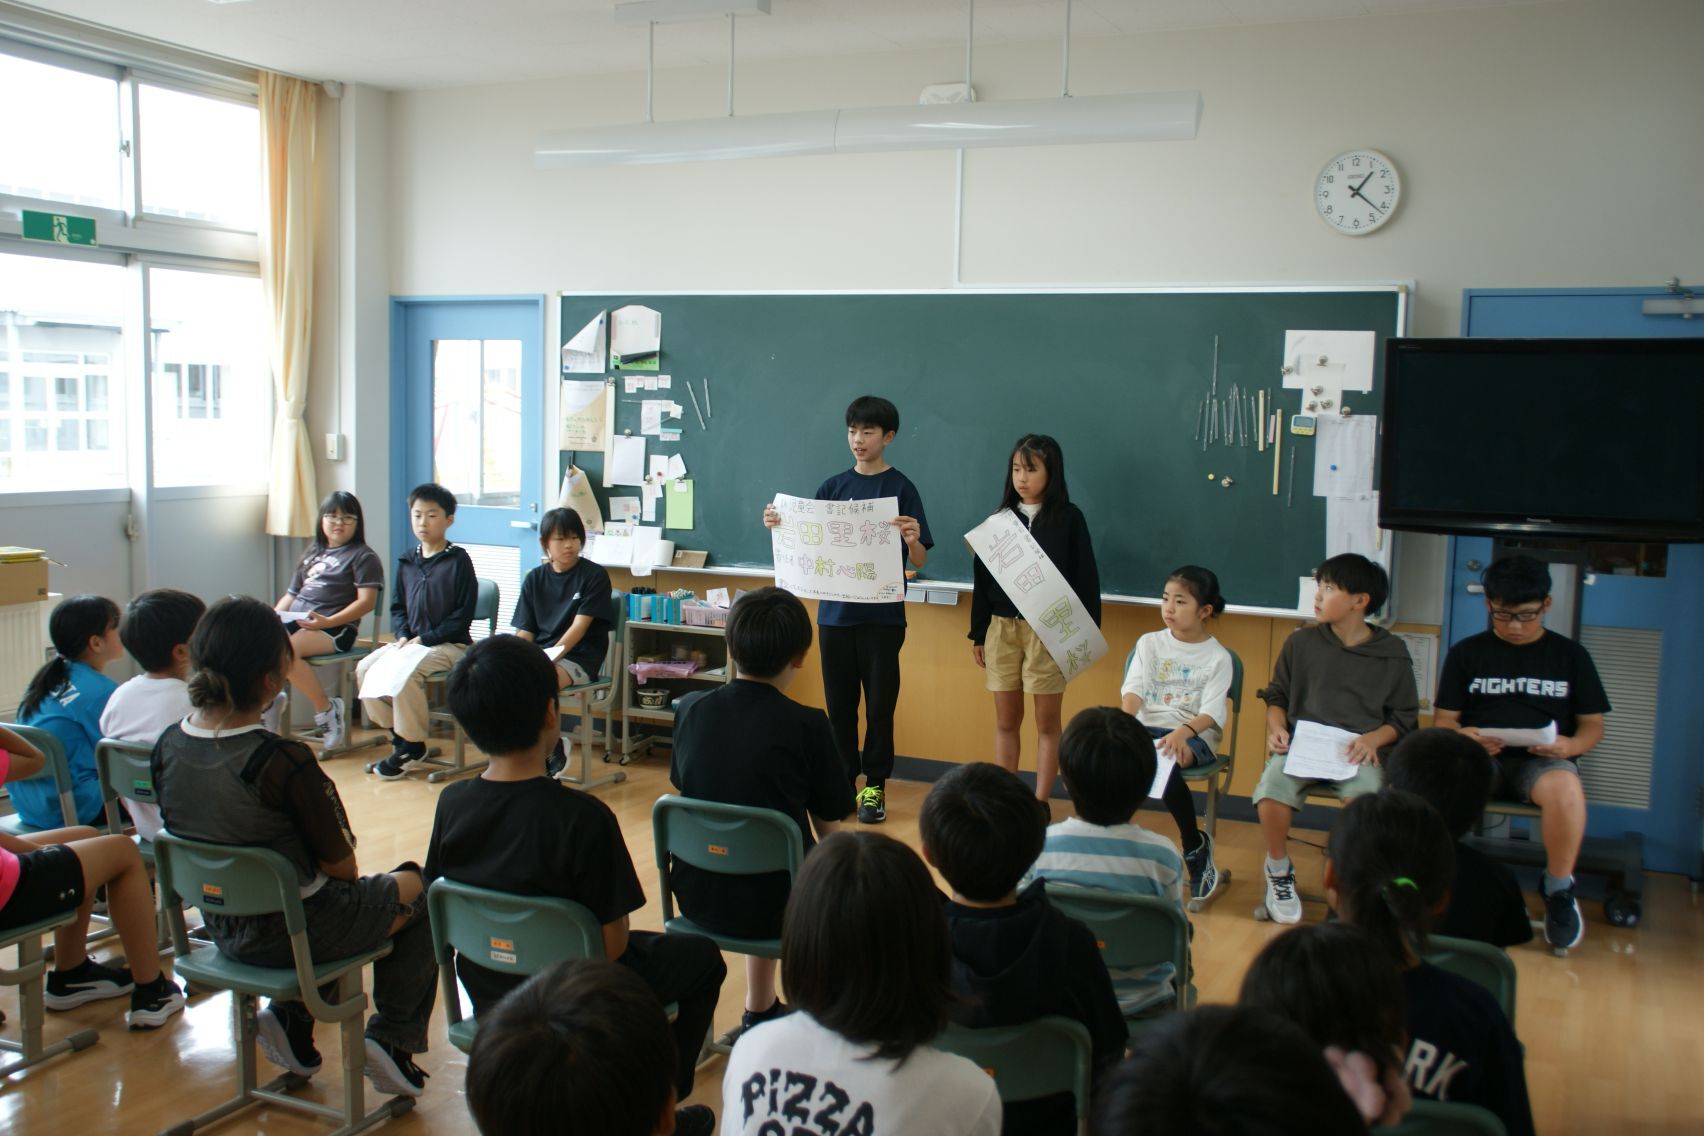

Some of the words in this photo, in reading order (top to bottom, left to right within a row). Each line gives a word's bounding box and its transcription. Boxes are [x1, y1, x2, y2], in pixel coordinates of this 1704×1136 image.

[1352, 158, 1360, 166] 12
[1338, 163, 1344, 171] 11
[1380, 169, 1386, 178] 2
[1326, 175, 1334, 184] 10
[1322, 190, 1329, 198] 9
[1384, 185, 1390, 194] 3
[1326, 205, 1333, 214] 8
[1380, 201, 1386, 209] 4
[1338, 215, 1344, 224] 7
[1368, 212, 1376, 223] 5
[1352, 219, 1360, 227] 6
[988, 528, 1093, 677] 岩田里桜
[1469, 677, 1569, 697] FIGHTERS
